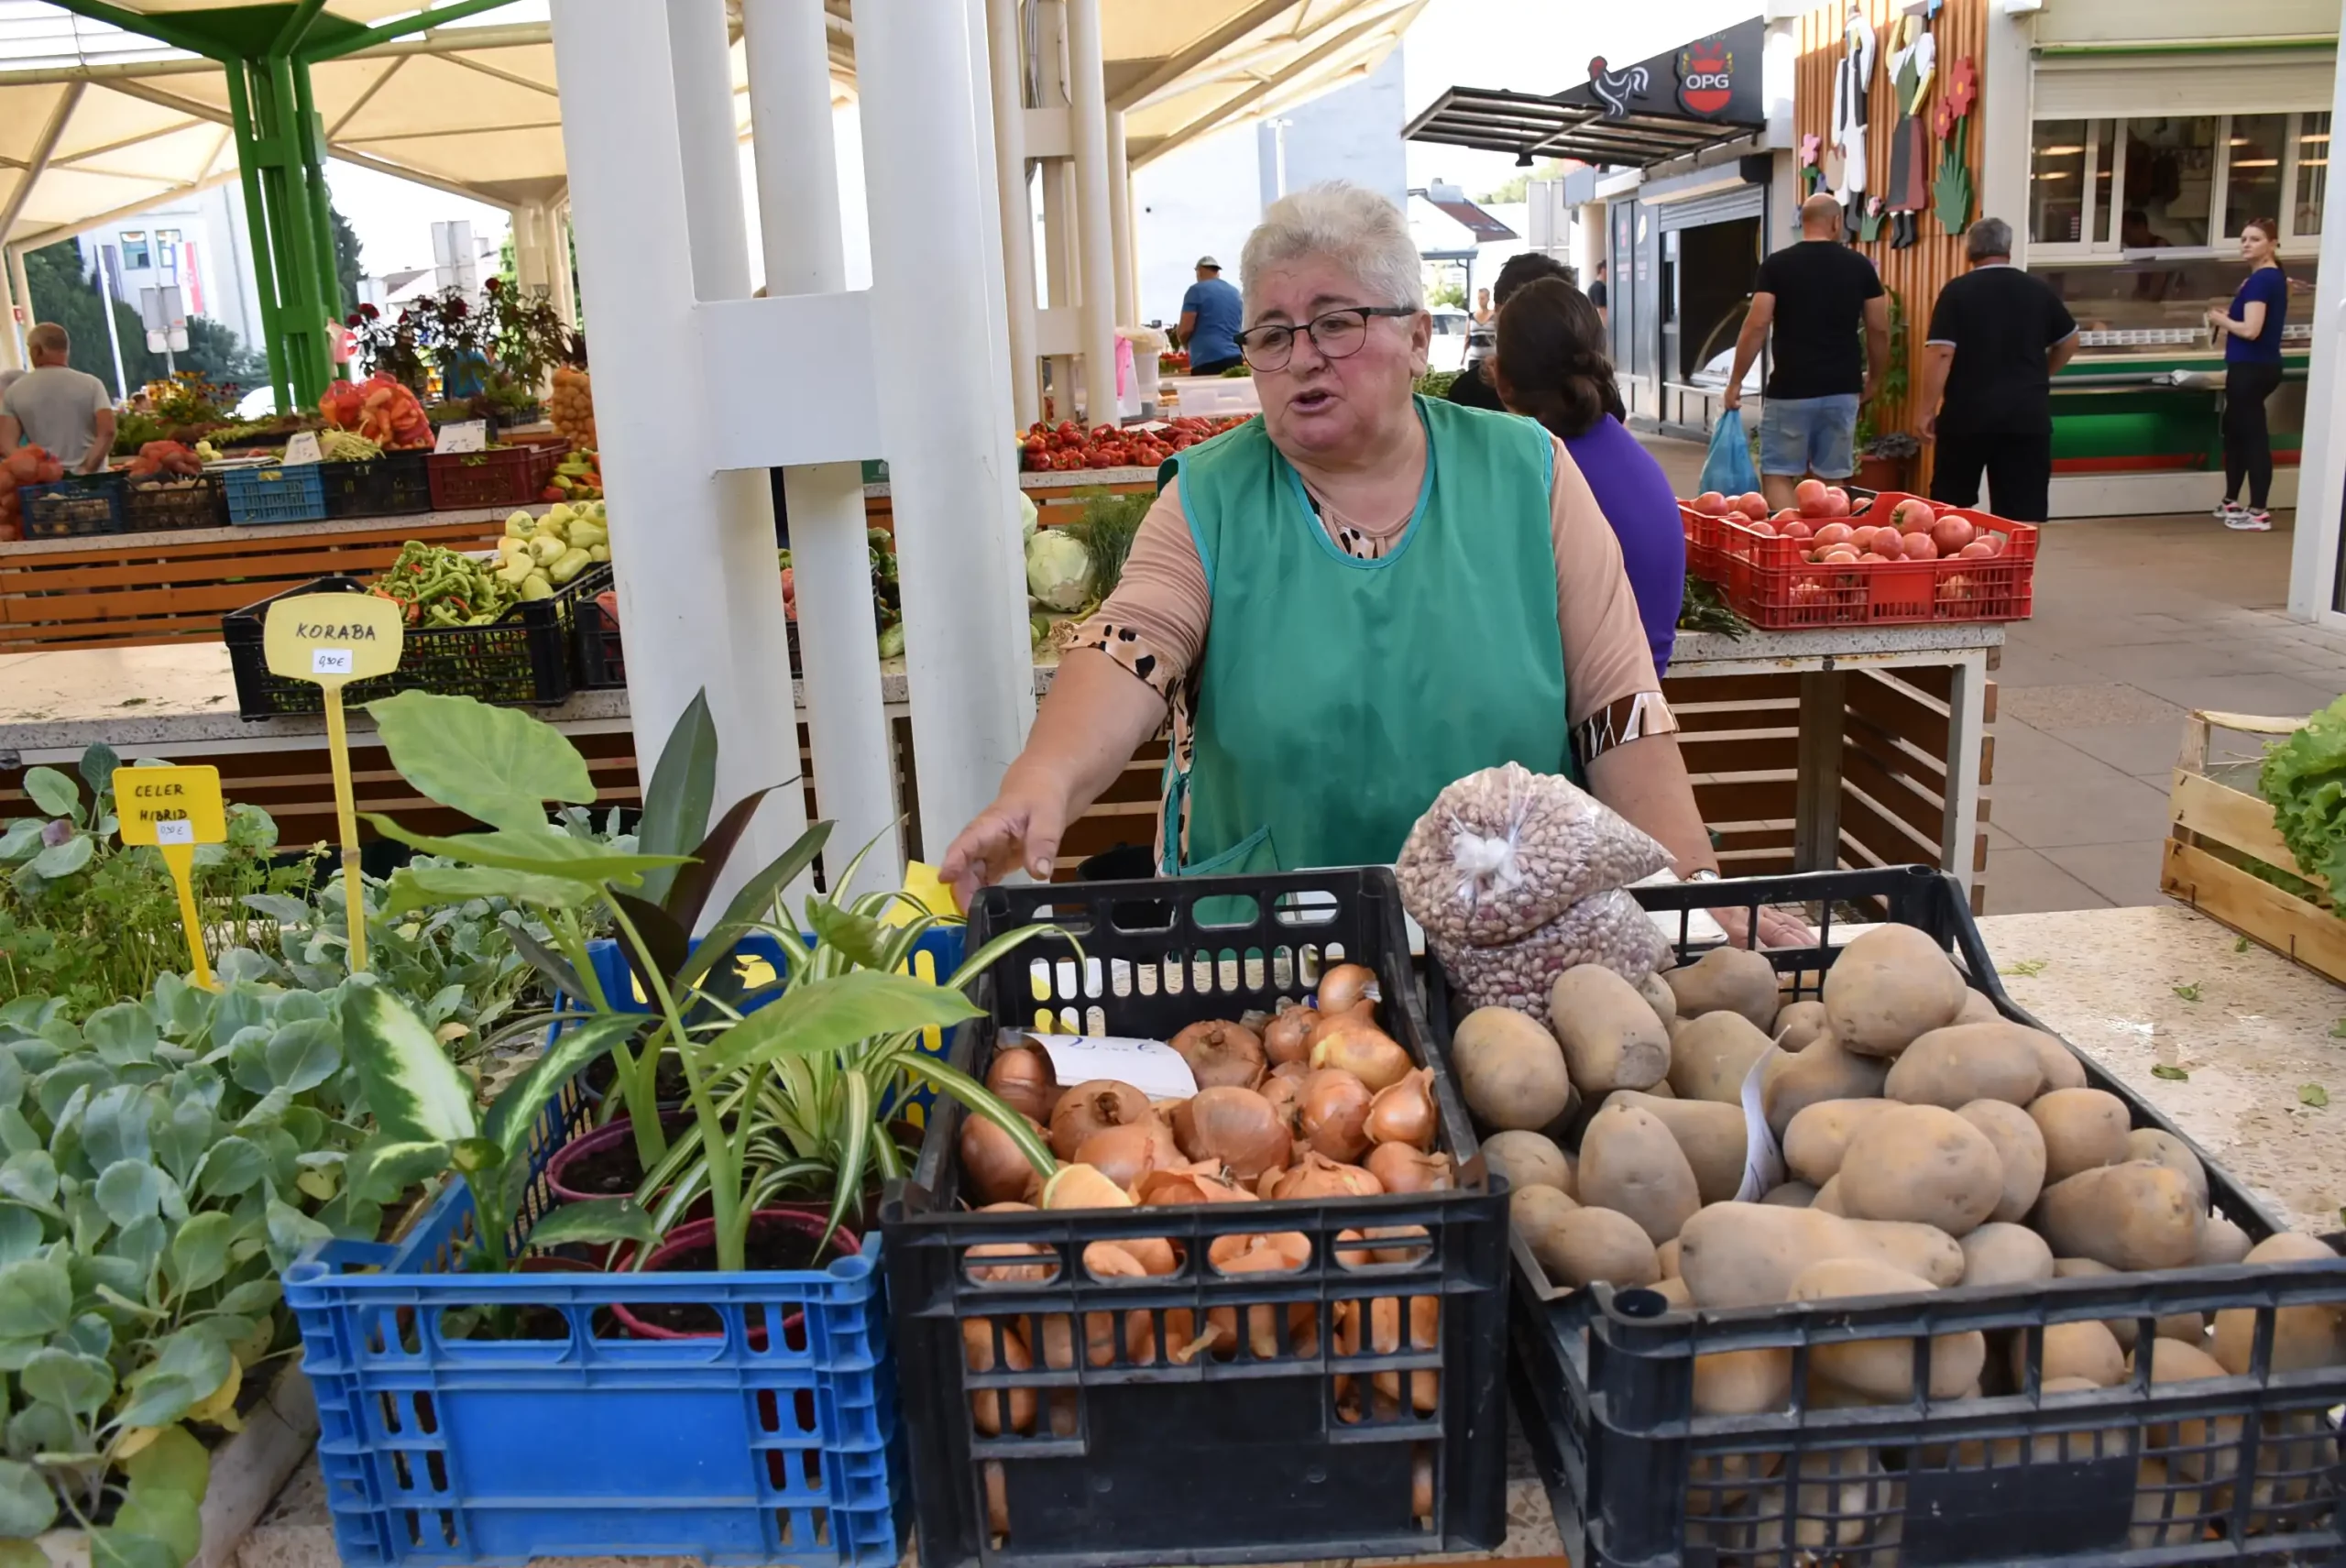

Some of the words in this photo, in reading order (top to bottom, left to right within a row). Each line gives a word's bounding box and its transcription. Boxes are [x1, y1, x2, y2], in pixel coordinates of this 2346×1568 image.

[1685, 73, 1730, 90] OPG
[296, 622, 376, 641] KORABA
[135, 784, 185, 797] CELER
[140, 808, 188, 822] HIBRID
